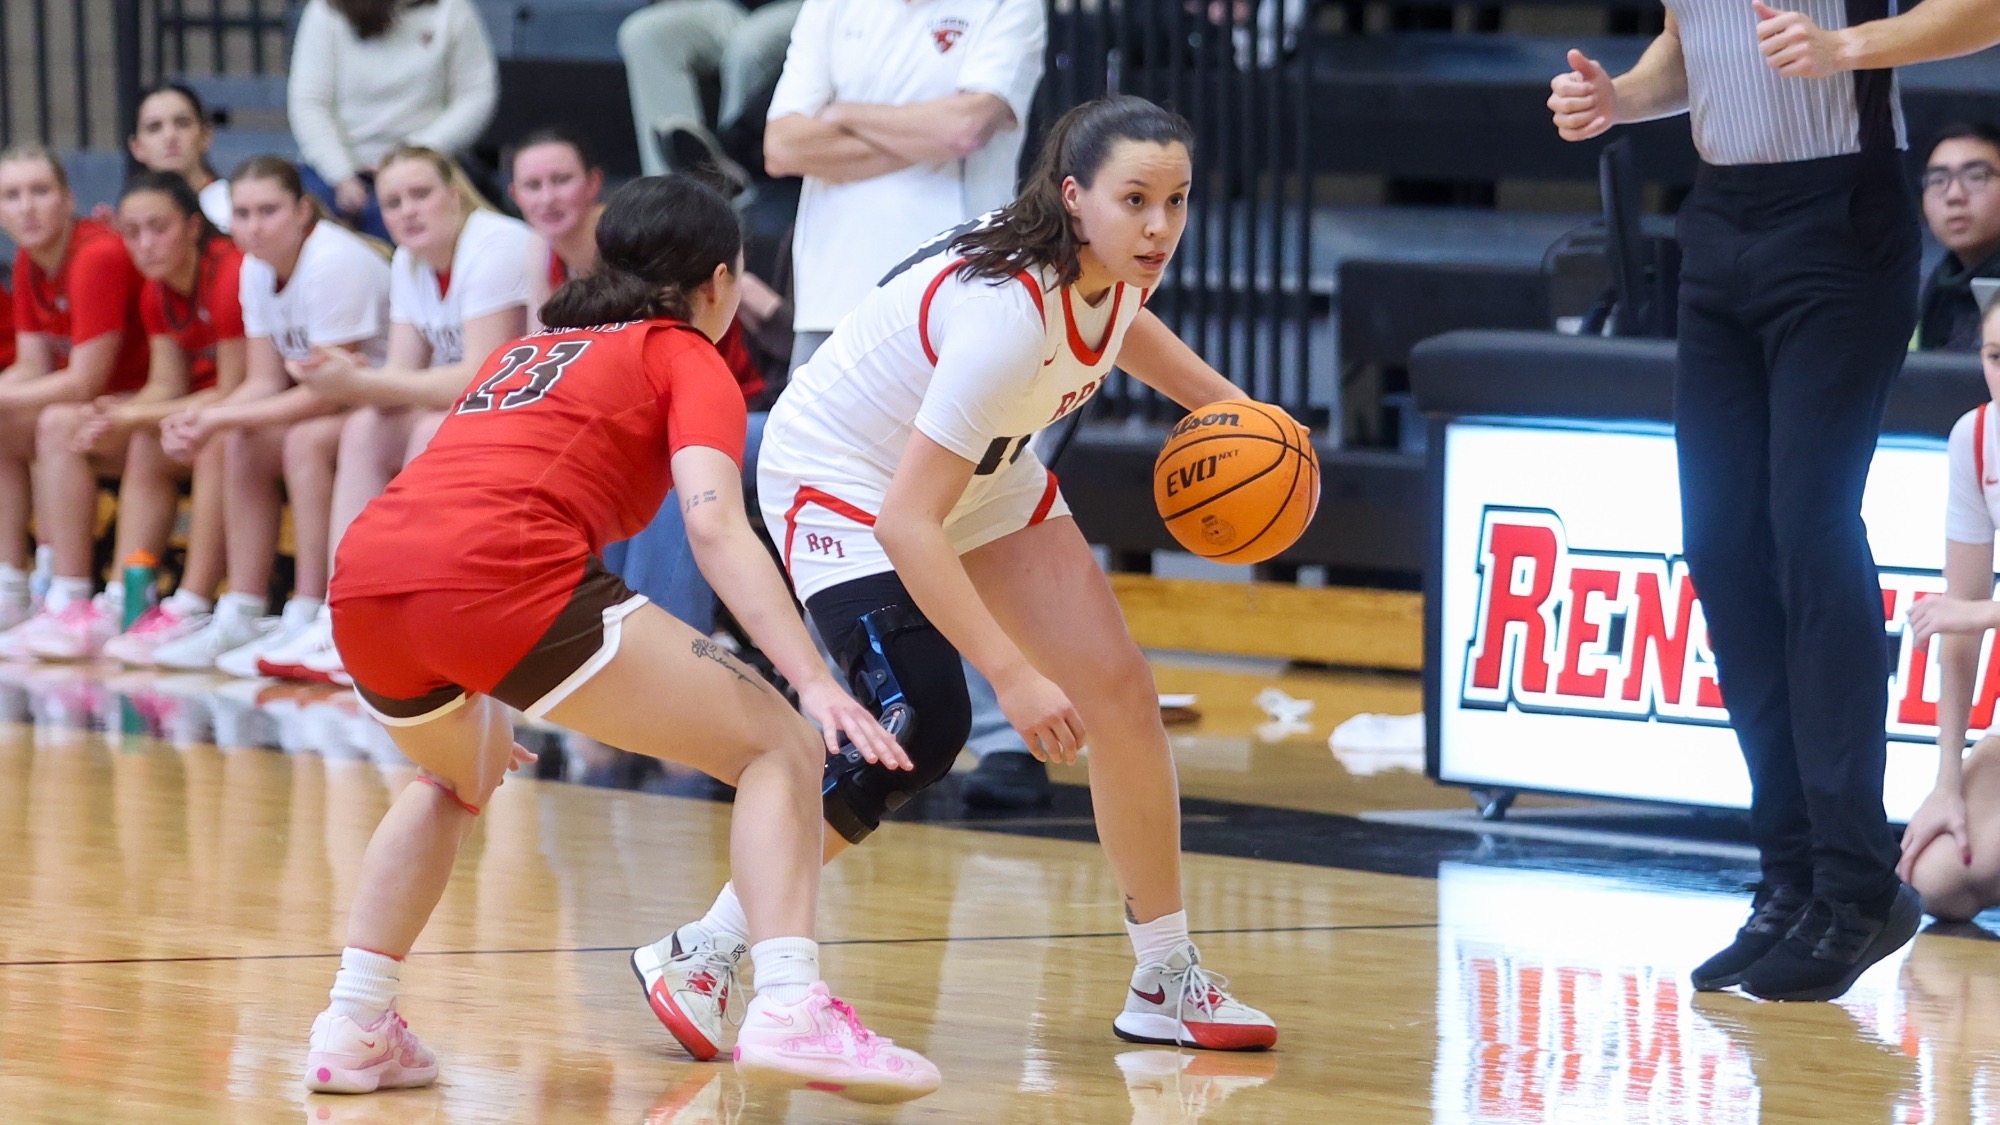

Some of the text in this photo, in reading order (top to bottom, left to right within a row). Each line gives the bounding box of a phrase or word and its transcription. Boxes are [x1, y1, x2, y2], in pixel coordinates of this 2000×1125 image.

[455, 340, 593, 415] 23
[1046, 372, 1108, 423] RP
[806, 532, 846, 559] RPI
